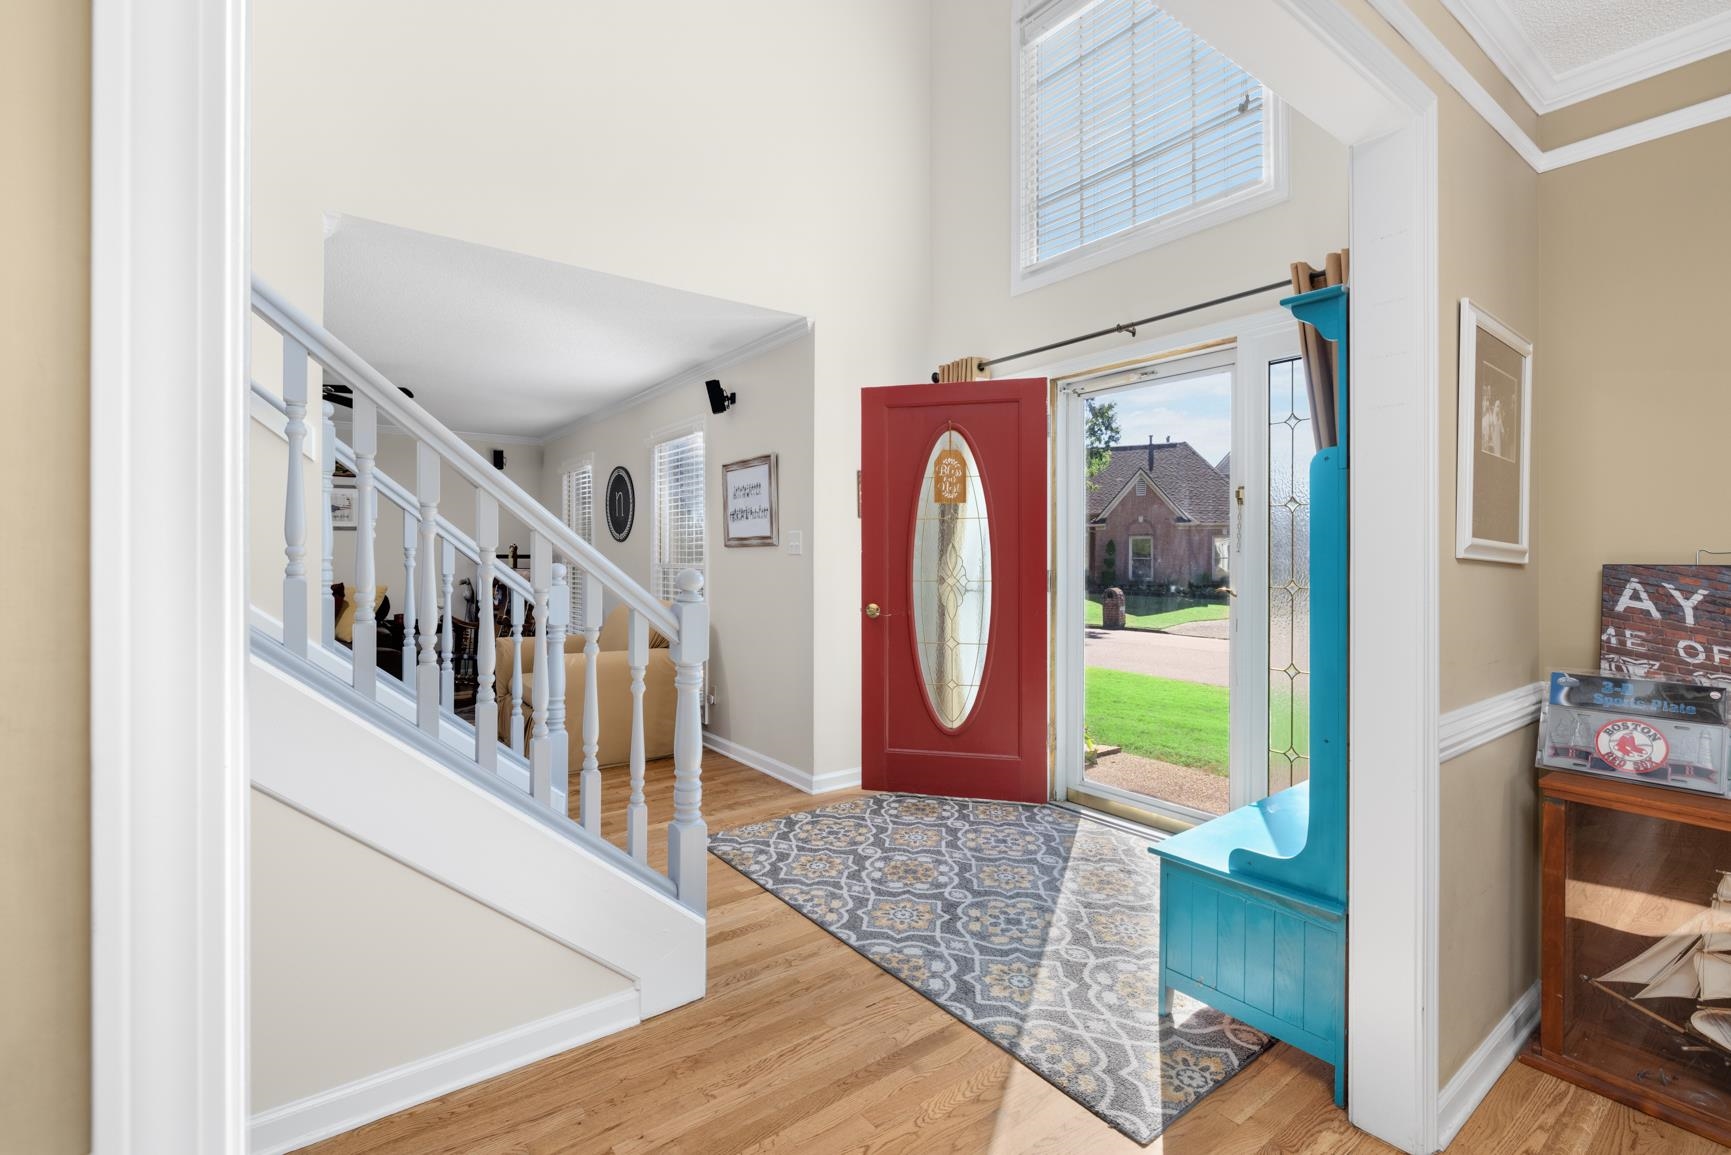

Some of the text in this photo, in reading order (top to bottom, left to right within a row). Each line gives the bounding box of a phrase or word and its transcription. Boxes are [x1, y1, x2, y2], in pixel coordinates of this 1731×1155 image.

[1614, 577, 1710, 627] AY
[1651, 699, 1697, 715] Plate
[1603, 722, 1662, 742] BOSTON
[1604, 751, 1660, 771] RED SOX
